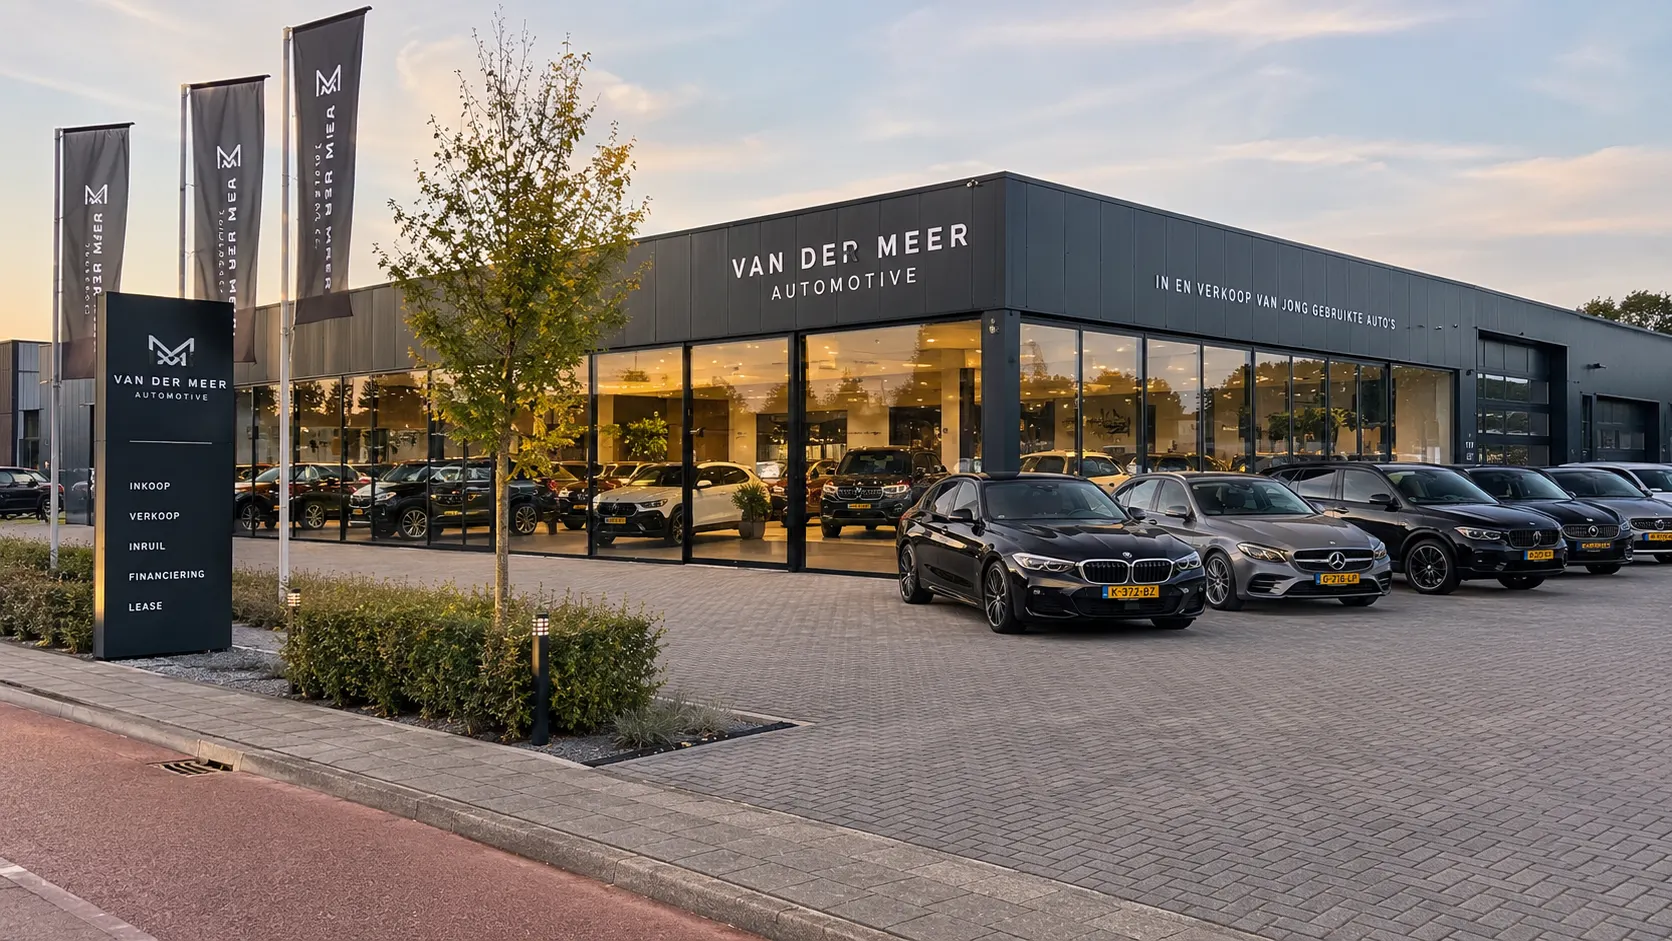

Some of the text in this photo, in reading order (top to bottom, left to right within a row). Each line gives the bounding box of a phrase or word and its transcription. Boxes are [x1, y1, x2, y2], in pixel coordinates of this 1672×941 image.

[731, 223, 968, 279] VAN DER MEER
[771, 267, 917, 300] AUTOMOTIVE
[1156, 274, 1396, 330] IN EN VERKOOP VAN JONG GEBRUIKTE AUTO'S
[113, 374, 227, 389] VAN DER MEER
[134, 391, 208, 402] AUTOMOTIVE
[129, 481, 171, 491] INKOOP
[129, 511, 180, 521] VERKOOP
[129, 541, 166, 551] INRUIL
[128, 569, 205, 581] FINANCIERING
[128, 601, 163, 612] LEASE
